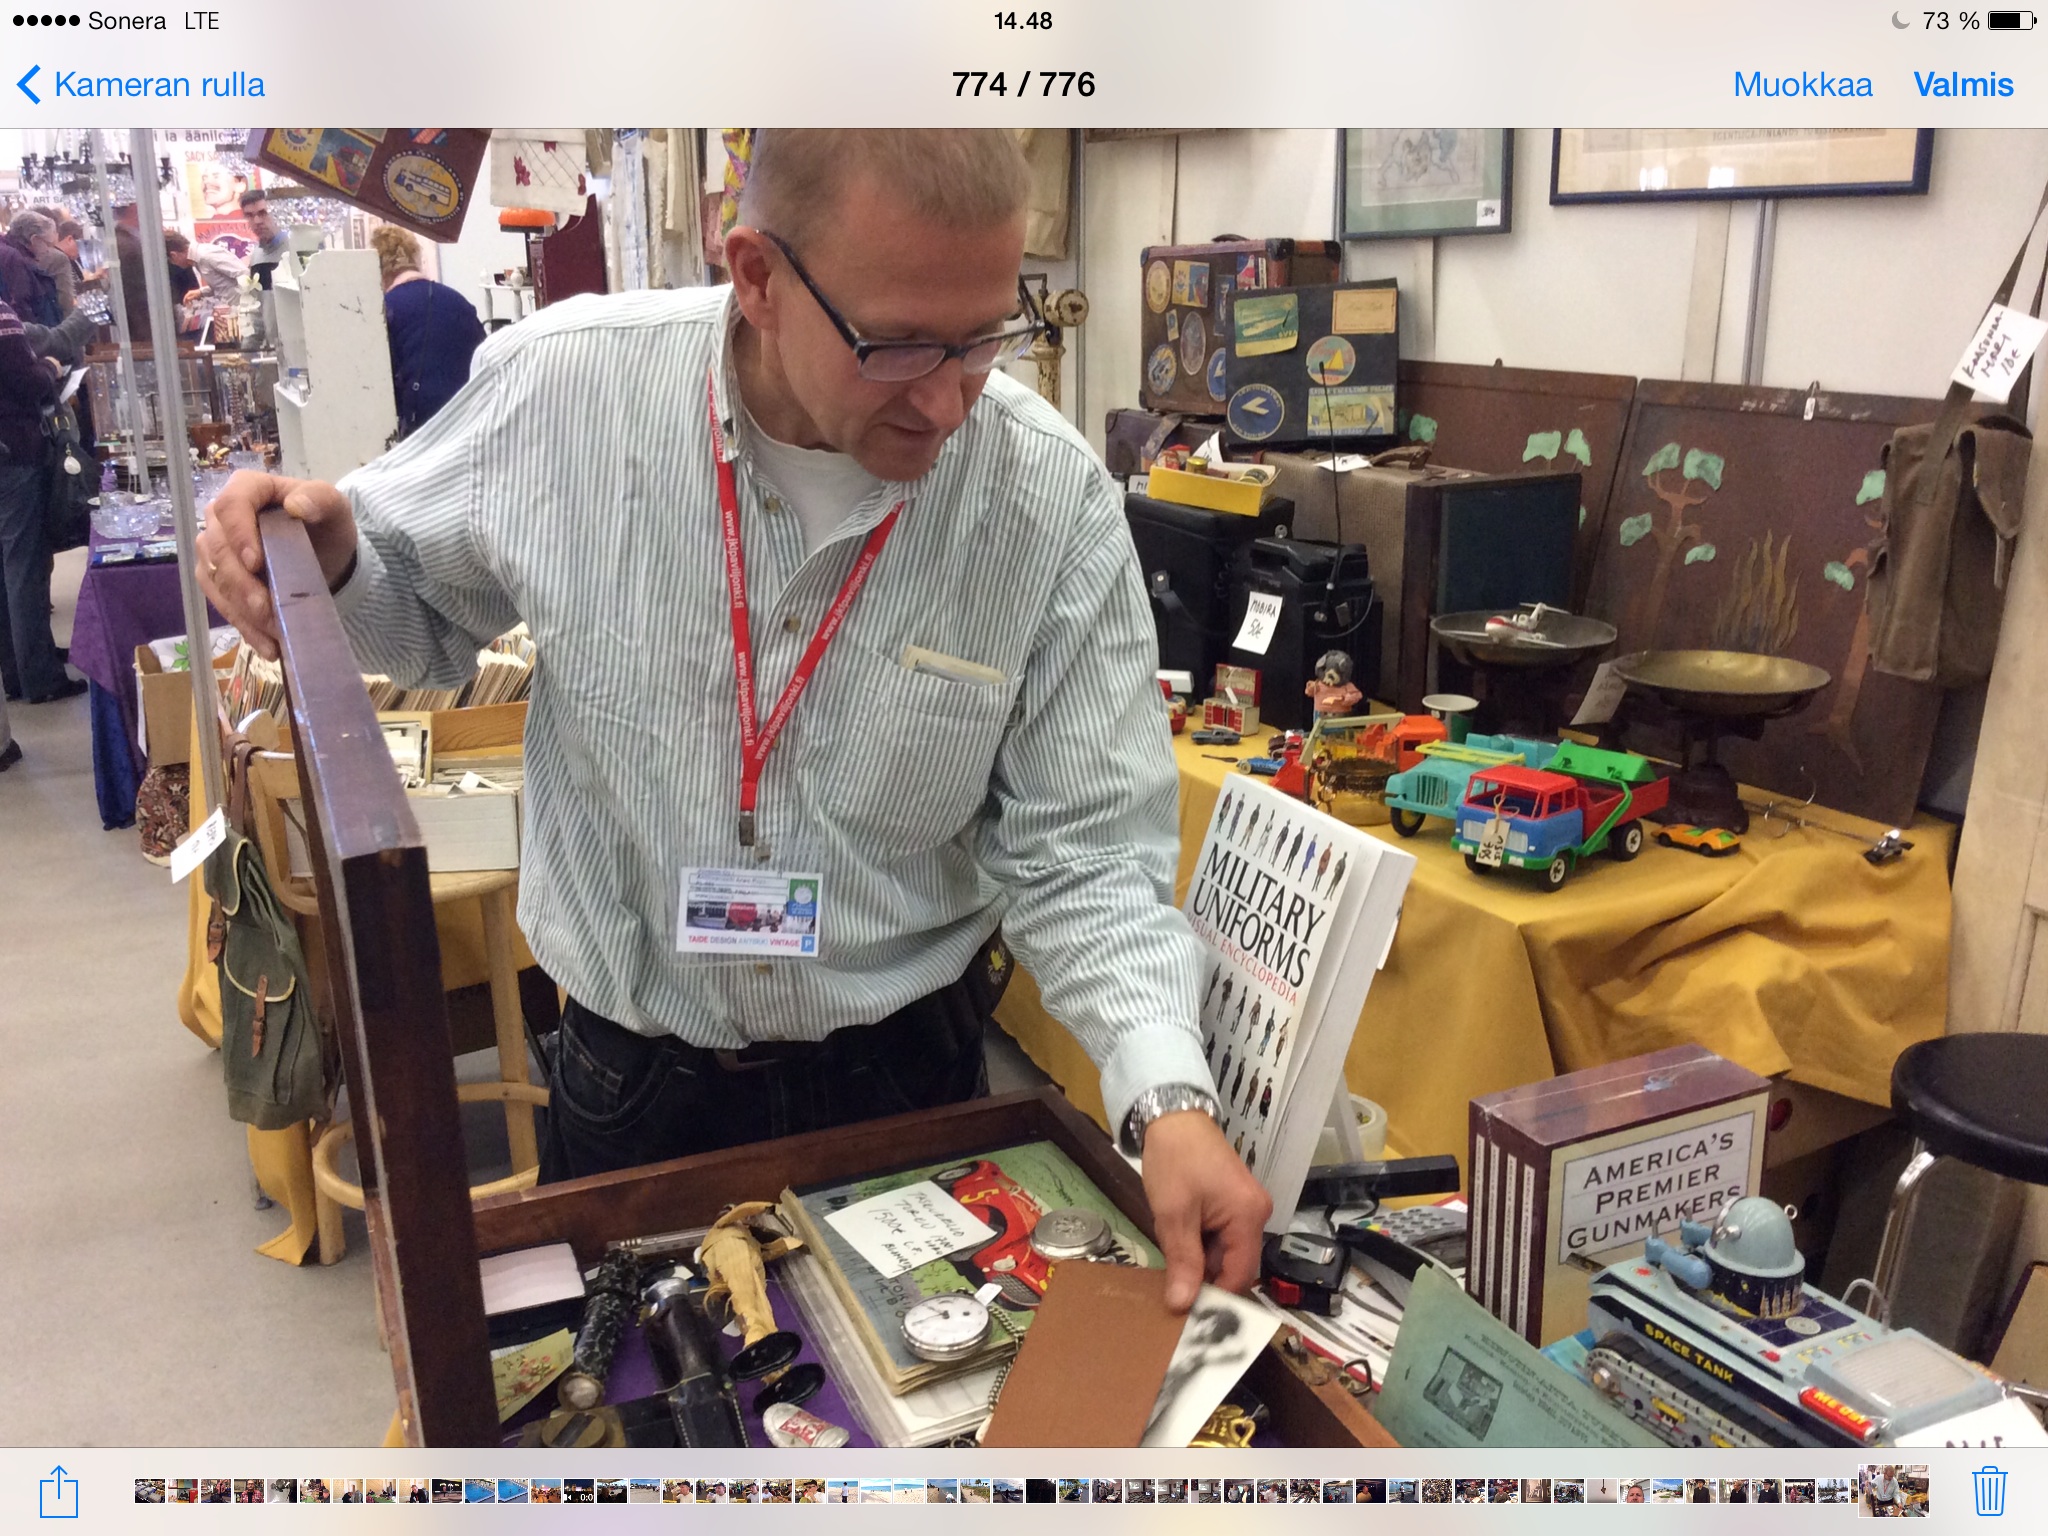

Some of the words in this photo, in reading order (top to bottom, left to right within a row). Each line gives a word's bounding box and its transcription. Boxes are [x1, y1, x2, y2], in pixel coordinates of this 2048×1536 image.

[1250, 599, 1276, 618] MOBIRA
[1203, 841, 1326, 945] MILITARY
[688, 935, 709, 944] TAIDE
[710, 935, 737, 945] DESIGN
[770, 938, 800, 948] VINTAGE
[1193, 877, 1311, 988] UNIFORMS
[1220, 938, 1297, 1006] ENCYCLOPEDIA
[1583, 1132, 1734, 1190] AMERICA'S
[1595, 1164, 1720, 1215] PREMIER
[1567, 1185, 1741, 1249] GUNMAKERS
[1645, 1323, 1690, 1359] SPACE
[1695, 1352, 1734, 1383] TANK
